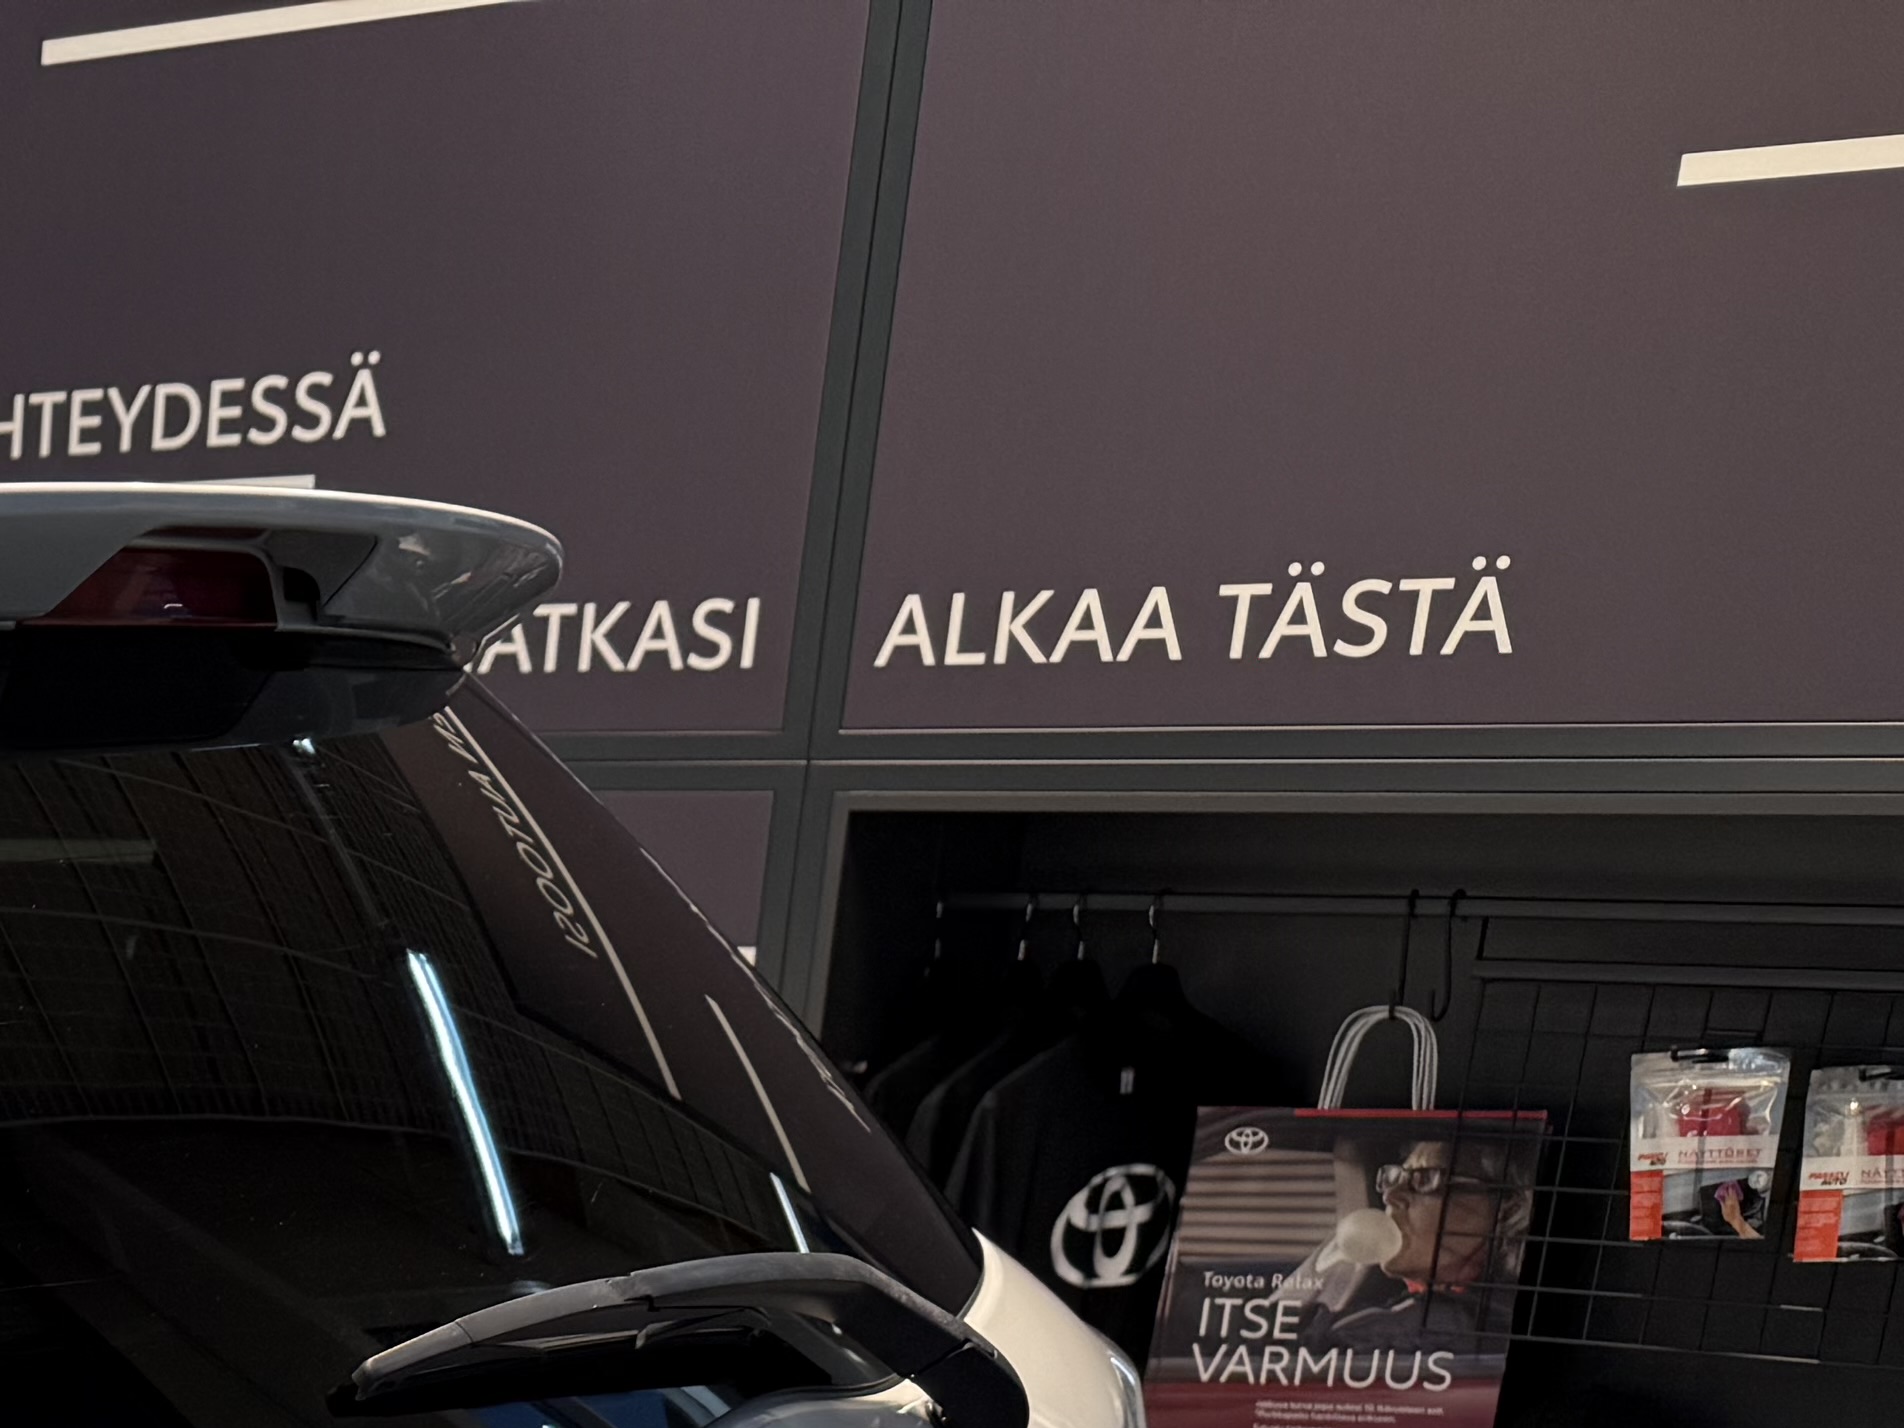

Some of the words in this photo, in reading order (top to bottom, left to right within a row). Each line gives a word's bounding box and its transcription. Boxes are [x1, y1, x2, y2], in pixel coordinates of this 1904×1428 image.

[463, 597, 760, 674] ATKASI
[873, 584, 1183, 669] ALKAA
[1218, 555, 1514, 661] TÄSTÄ
[1202, 1271, 1265, 1291] Toyota
[1271, 1272, 1325, 1291] Relax
[1198, 1296, 1303, 1340] ITSE
[1191, 1342, 1455, 1392] VARMUUS
